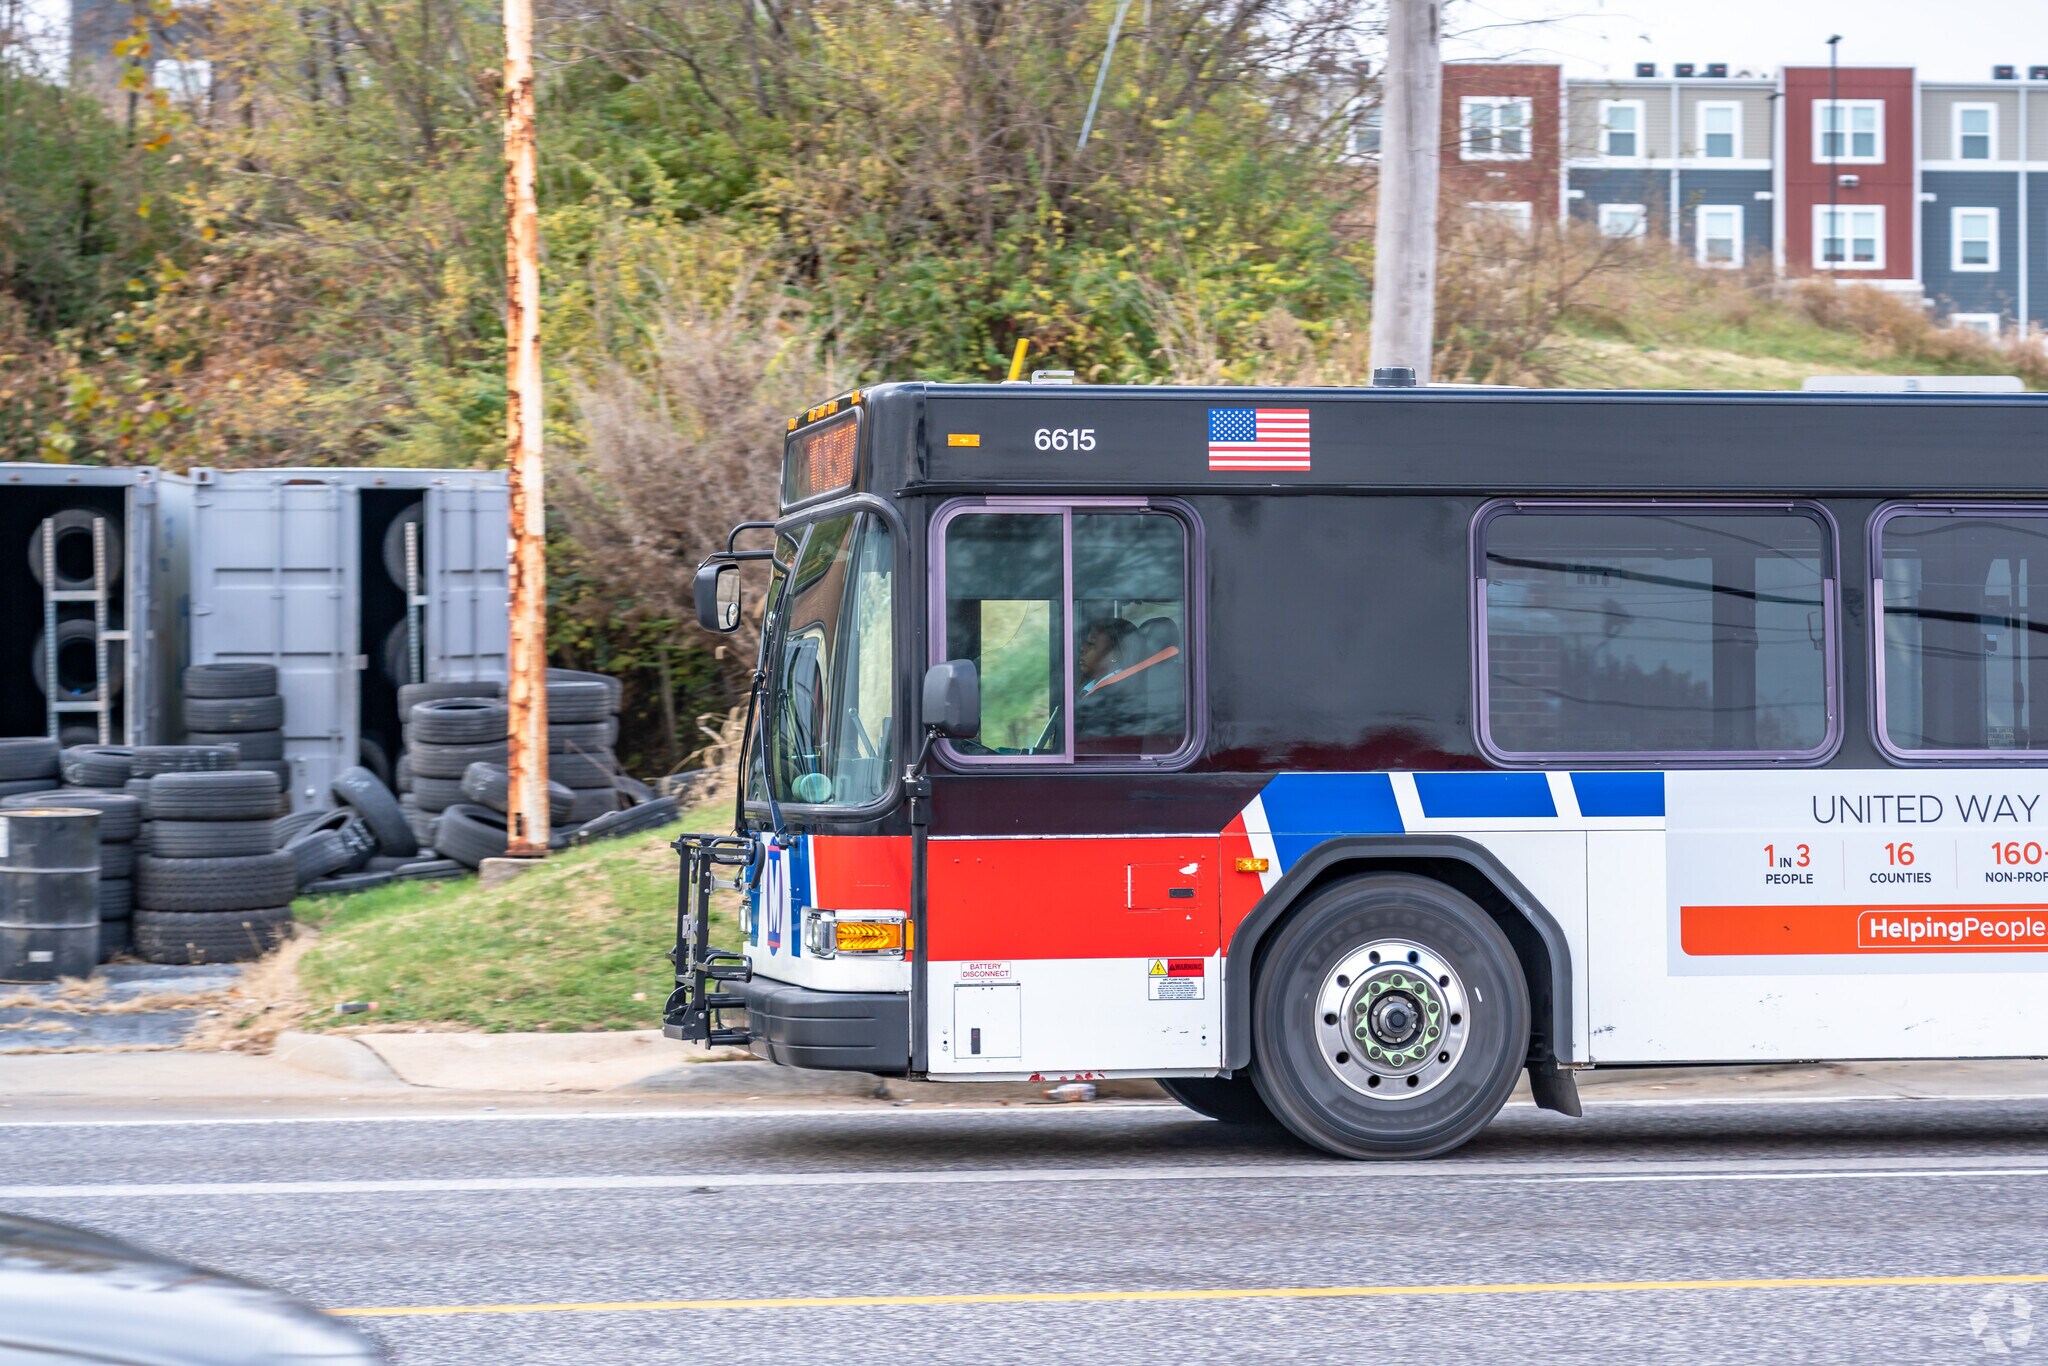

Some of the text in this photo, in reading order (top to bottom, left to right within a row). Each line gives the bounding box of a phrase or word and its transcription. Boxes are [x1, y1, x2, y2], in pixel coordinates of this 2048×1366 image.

[1034, 428, 1096, 451] 6615
[1812, 794, 2041, 824] UNITED WAY
[1764, 843, 1811, 868] 1 IN 3
[1884, 842, 1915, 866] 16
[1765, 873, 1814, 885] PEOPLE
[1869, 872, 1932, 884] COUNTIES
[962, 970, 1010, 978] DISCONNECT
[1175, 963, 1203, 971] WARNING
